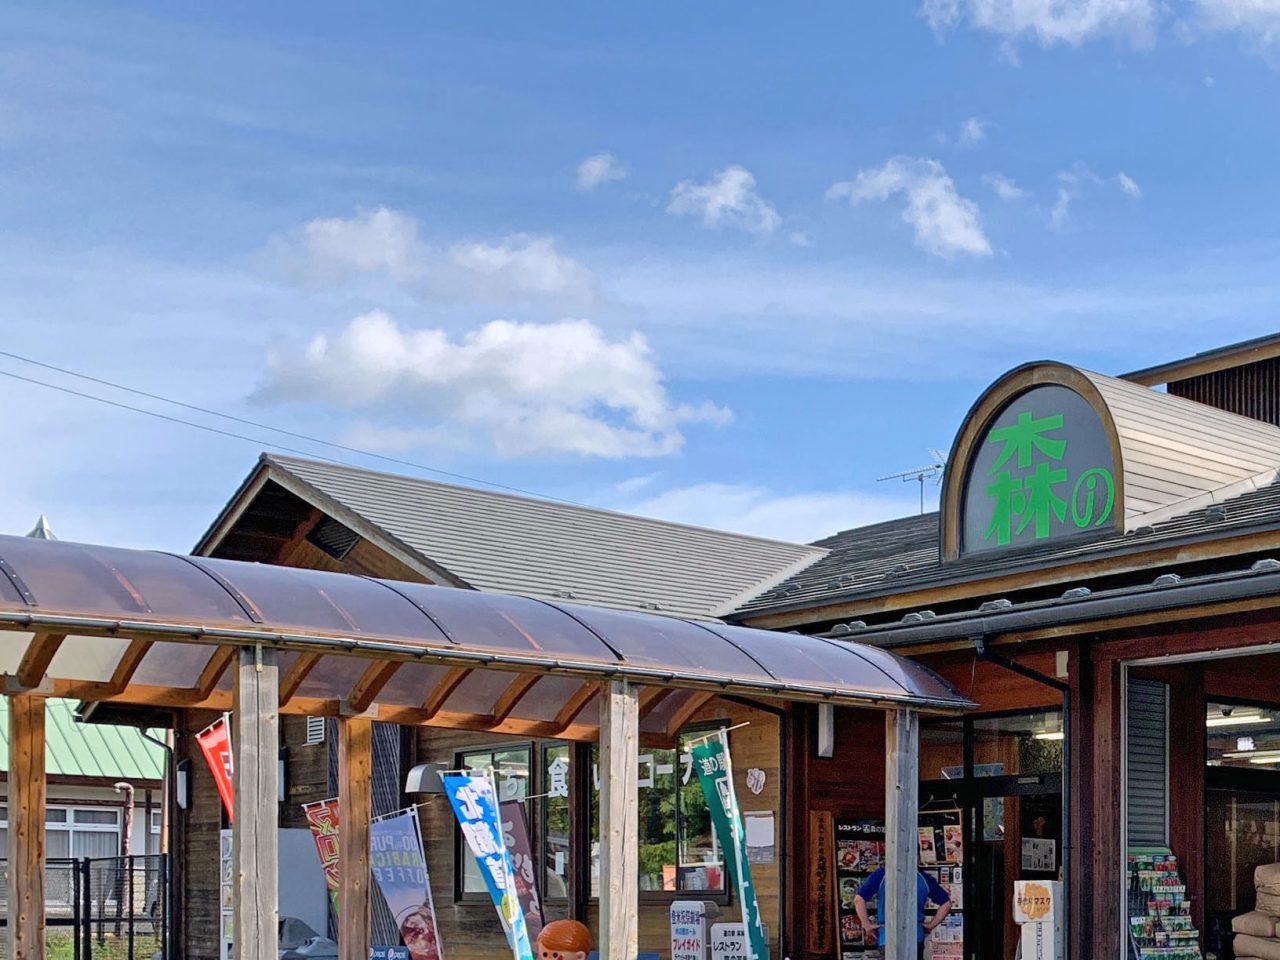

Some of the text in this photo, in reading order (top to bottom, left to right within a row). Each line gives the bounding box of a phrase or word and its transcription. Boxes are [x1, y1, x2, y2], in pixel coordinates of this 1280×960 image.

[983, 412, 1115, 546] 森の
[673, 938, 701, 951] プレイガイド
[713, 941, 742, 952] レストラン
